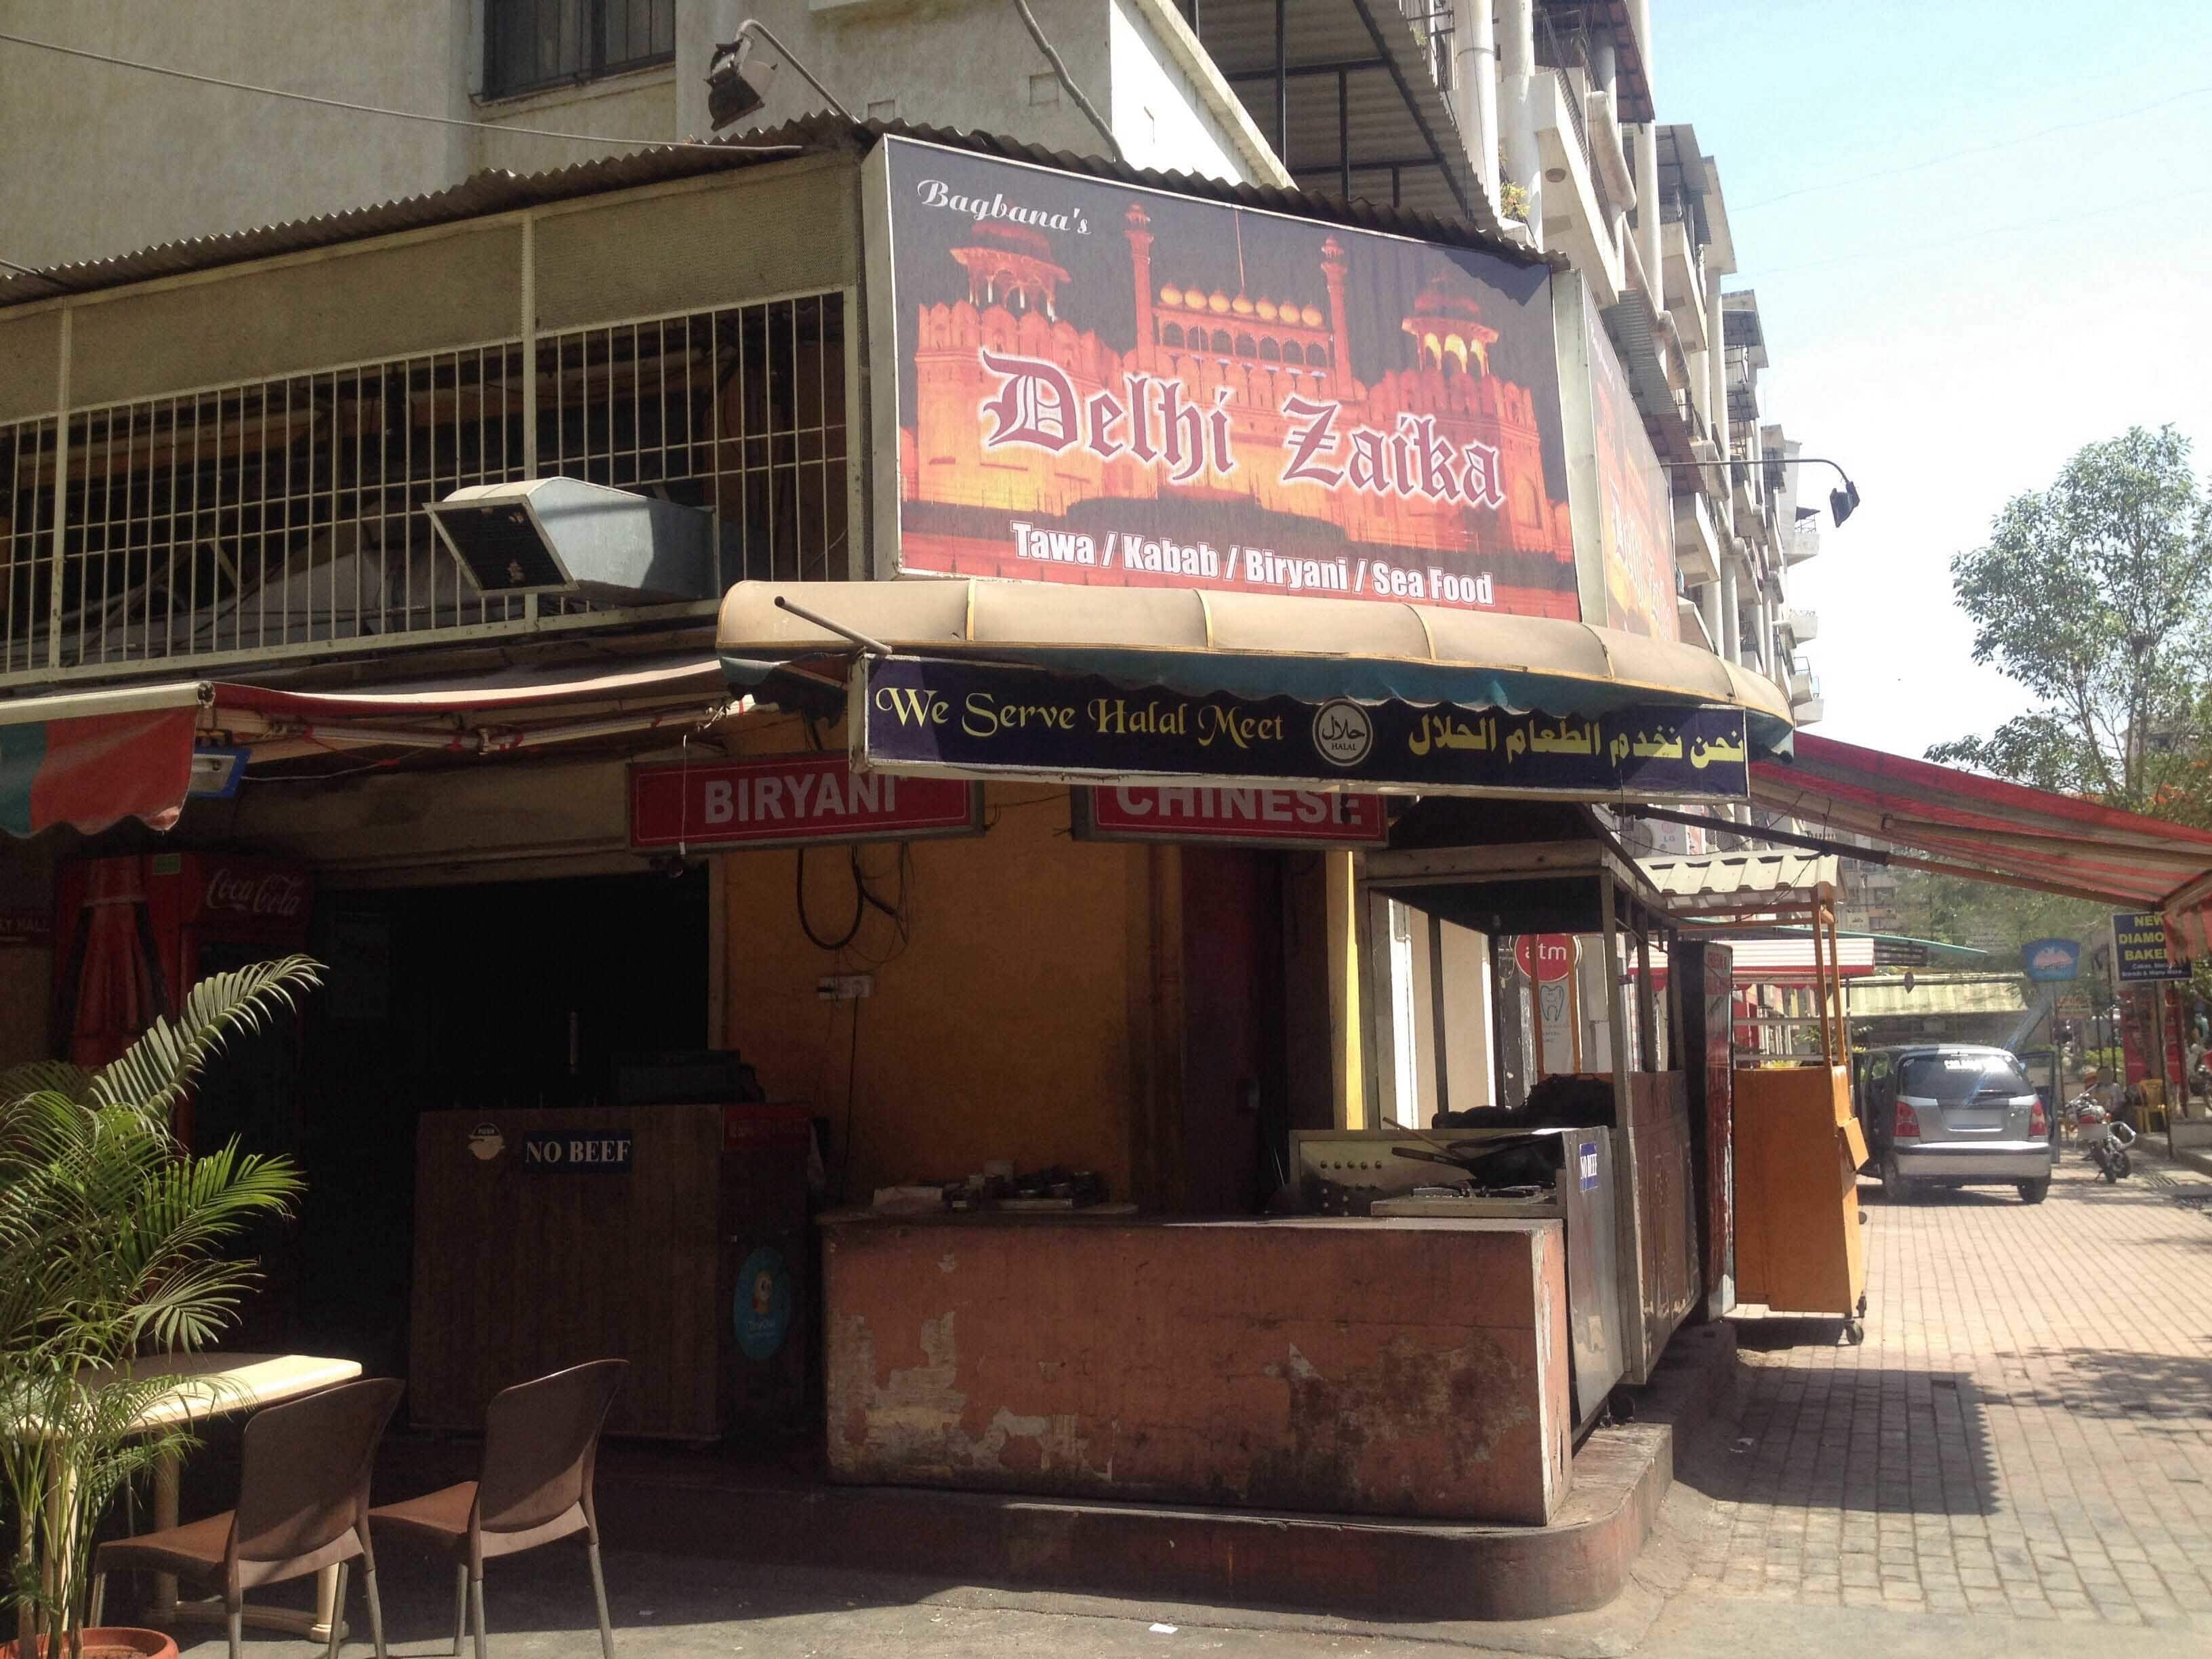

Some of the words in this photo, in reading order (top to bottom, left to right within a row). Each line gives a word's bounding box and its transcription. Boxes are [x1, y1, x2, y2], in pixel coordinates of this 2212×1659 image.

[917, 180, 1092, 234] Bagbana's
[981, 348, 1235, 481] Delhi
[1282, 396, 1503, 506] Zaika
[1010, 520, 1097, 567] Tawa
[1100, 531, 1118, 569] /
[1122, 533, 1221, 579] Kabab
[1224, 545, 1240, 581] /
[1243, 547, 1349, 591] Biryani
[1353, 558, 1368, 594] /
[1371, 560, 1426, 599] Sea
[1427, 566, 1496, 607] Food
[876, 687, 949, 728] We
[962, 692, 1076, 737] Serve
[1087, 698, 1187, 735] Halal
[1197, 705, 1284, 749] Meet
[1322, 715, 1366, 741] حلال
[1409, 714, 1497, 756] الحلال
[1505, 718, 1601, 764] الطعام
[1331, 742, 1356, 751] HALAL
[1690, 730, 1744, 769] نحن
[704, 771, 896, 825] BIRYANI
[525, 1140, 563, 1164] NO
[569, 1139, 631, 1164] BEEF
